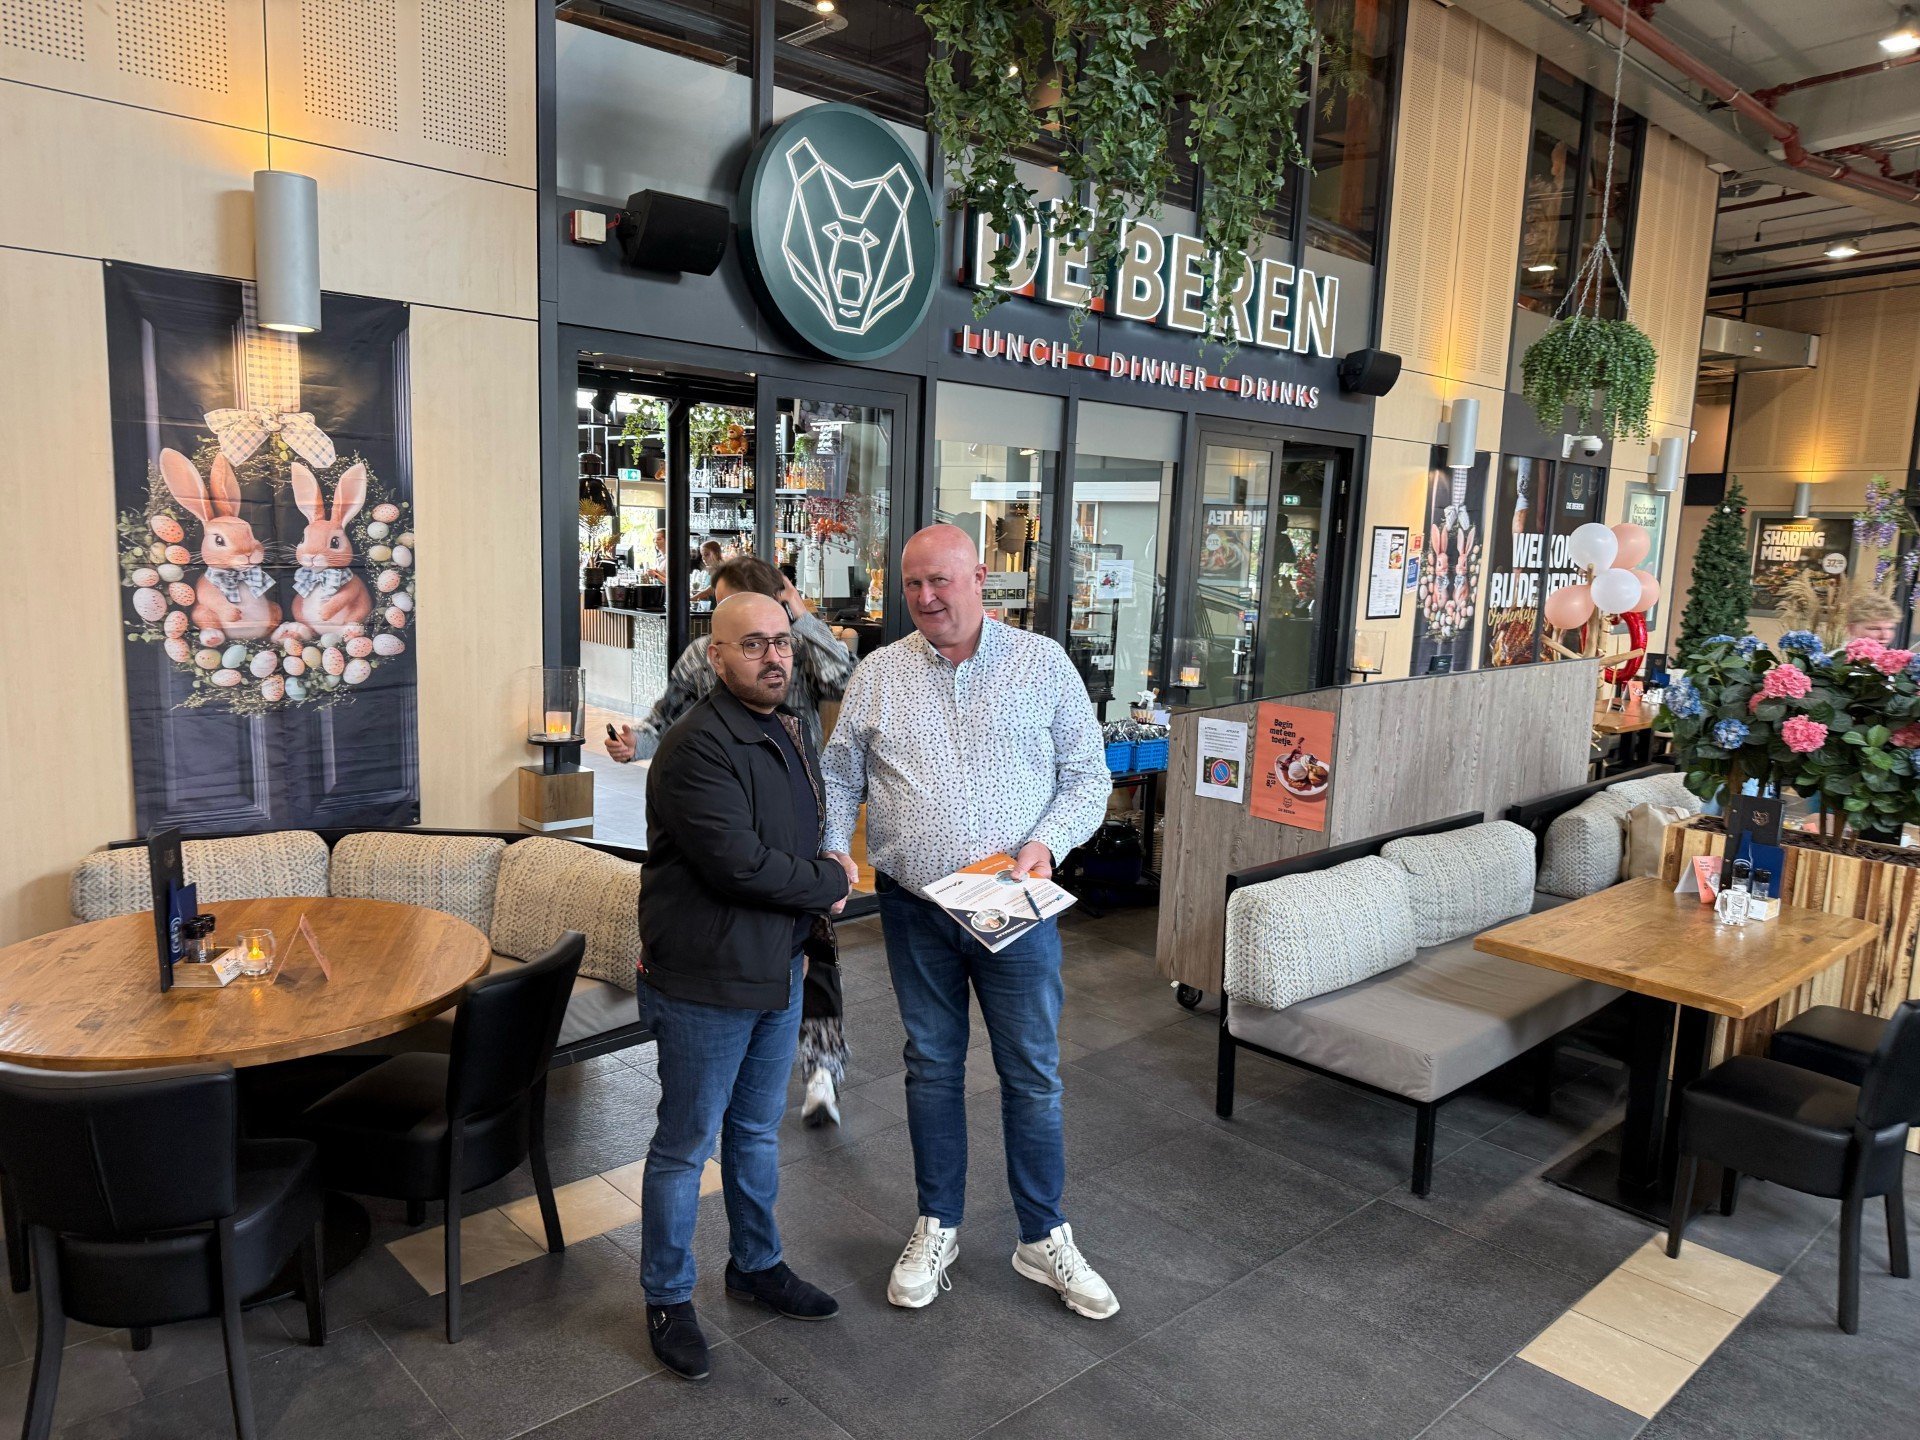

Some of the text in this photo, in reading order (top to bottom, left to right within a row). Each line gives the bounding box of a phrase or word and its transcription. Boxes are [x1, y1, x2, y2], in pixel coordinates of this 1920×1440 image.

[975, 198, 1339, 358] DE BEREN
[962, 325, 1321, 410] LUNCH DINNER DRINKS
[1762, 530, 1826, 547] SHARING
[1760, 545, 1802, 562] MENU
[1489, 572, 1516, 609] BIJ
[1517, 573, 1540, 609] DE
[1274, 718, 1293, 730] Begin
[1269, 728, 1296, 738] met een
[1271, 736, 1293, 747] toetje.
